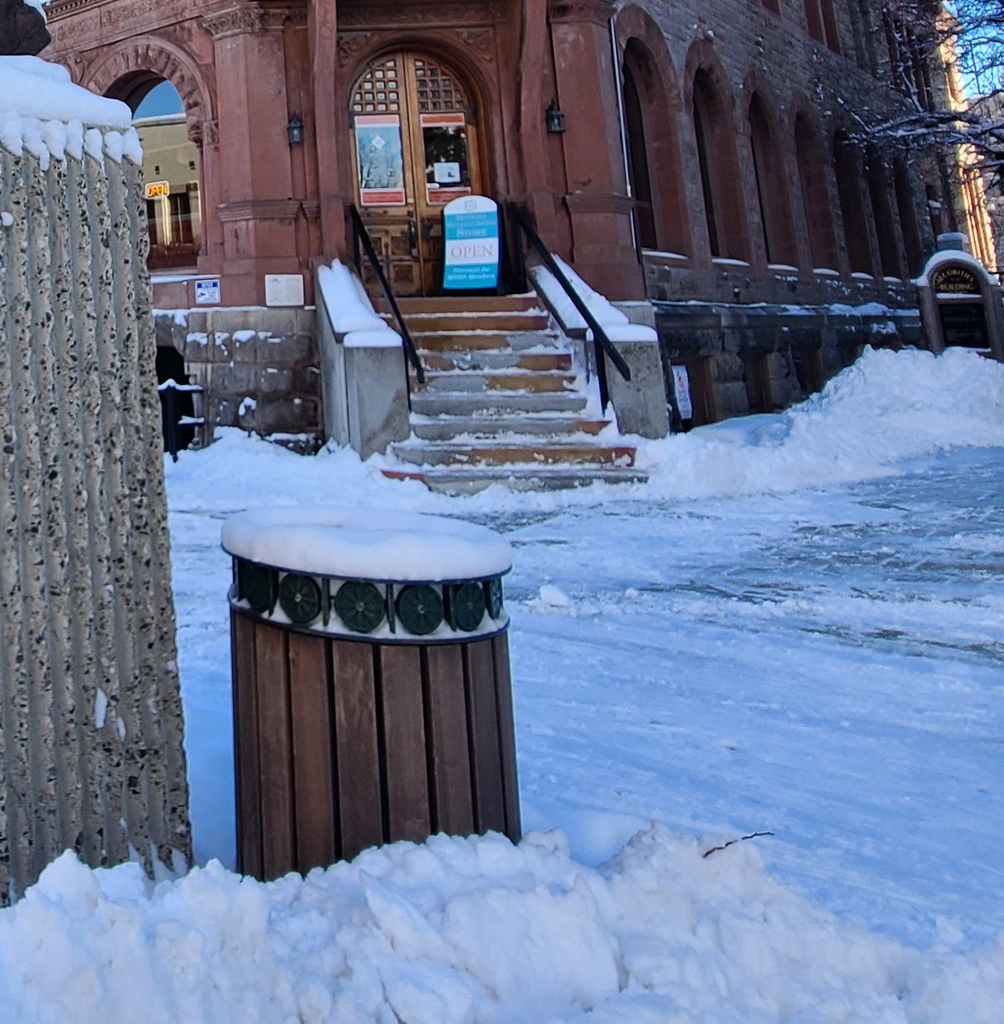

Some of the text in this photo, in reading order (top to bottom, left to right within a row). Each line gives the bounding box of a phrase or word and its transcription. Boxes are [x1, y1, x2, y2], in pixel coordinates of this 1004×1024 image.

[147, 183, 167, 197] OPEN
[451, 245, 493, 258] OPEN
[940, 283, 975, 291] BUILDING
